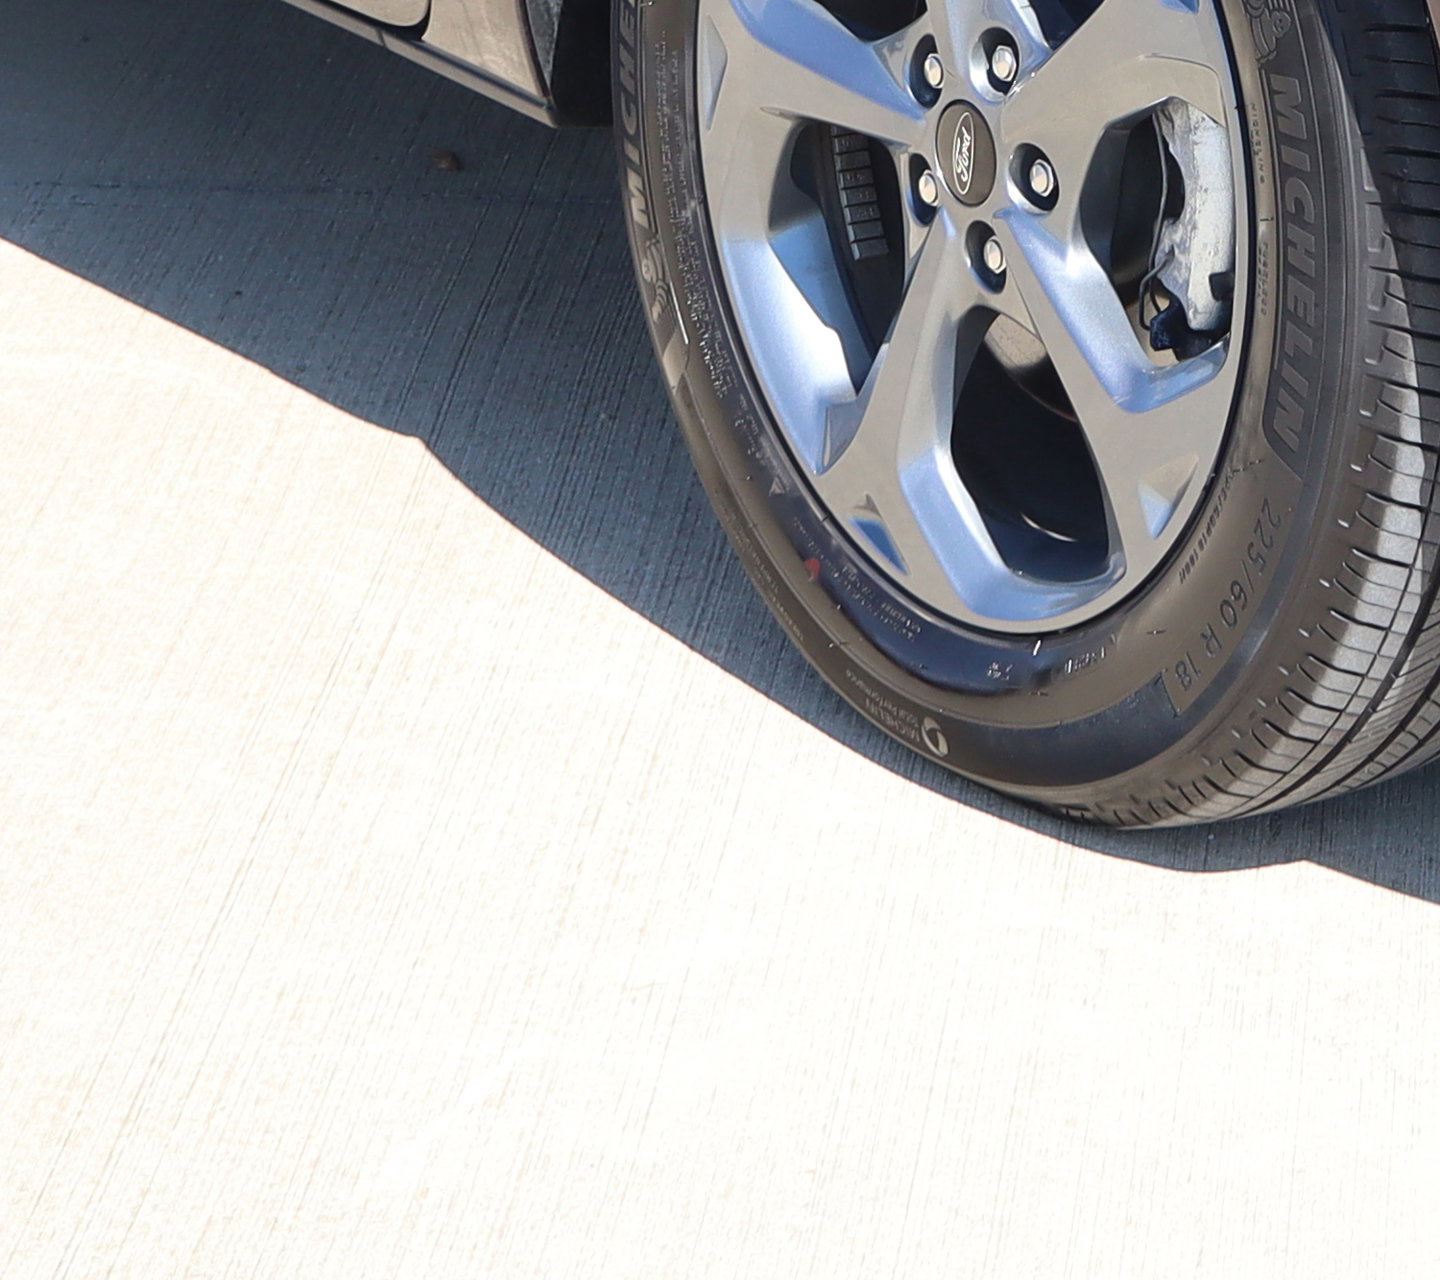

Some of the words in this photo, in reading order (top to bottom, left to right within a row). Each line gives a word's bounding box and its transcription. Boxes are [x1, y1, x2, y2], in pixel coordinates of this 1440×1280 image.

[954, 125, 972, 183] Ford
[1269, 72, 1317, 453] MICHELIN
[1219, 497, 1282, 629] 225/60
[1200, 622, 1222, 658] R
[1174, 651, 1201, 692] 18
